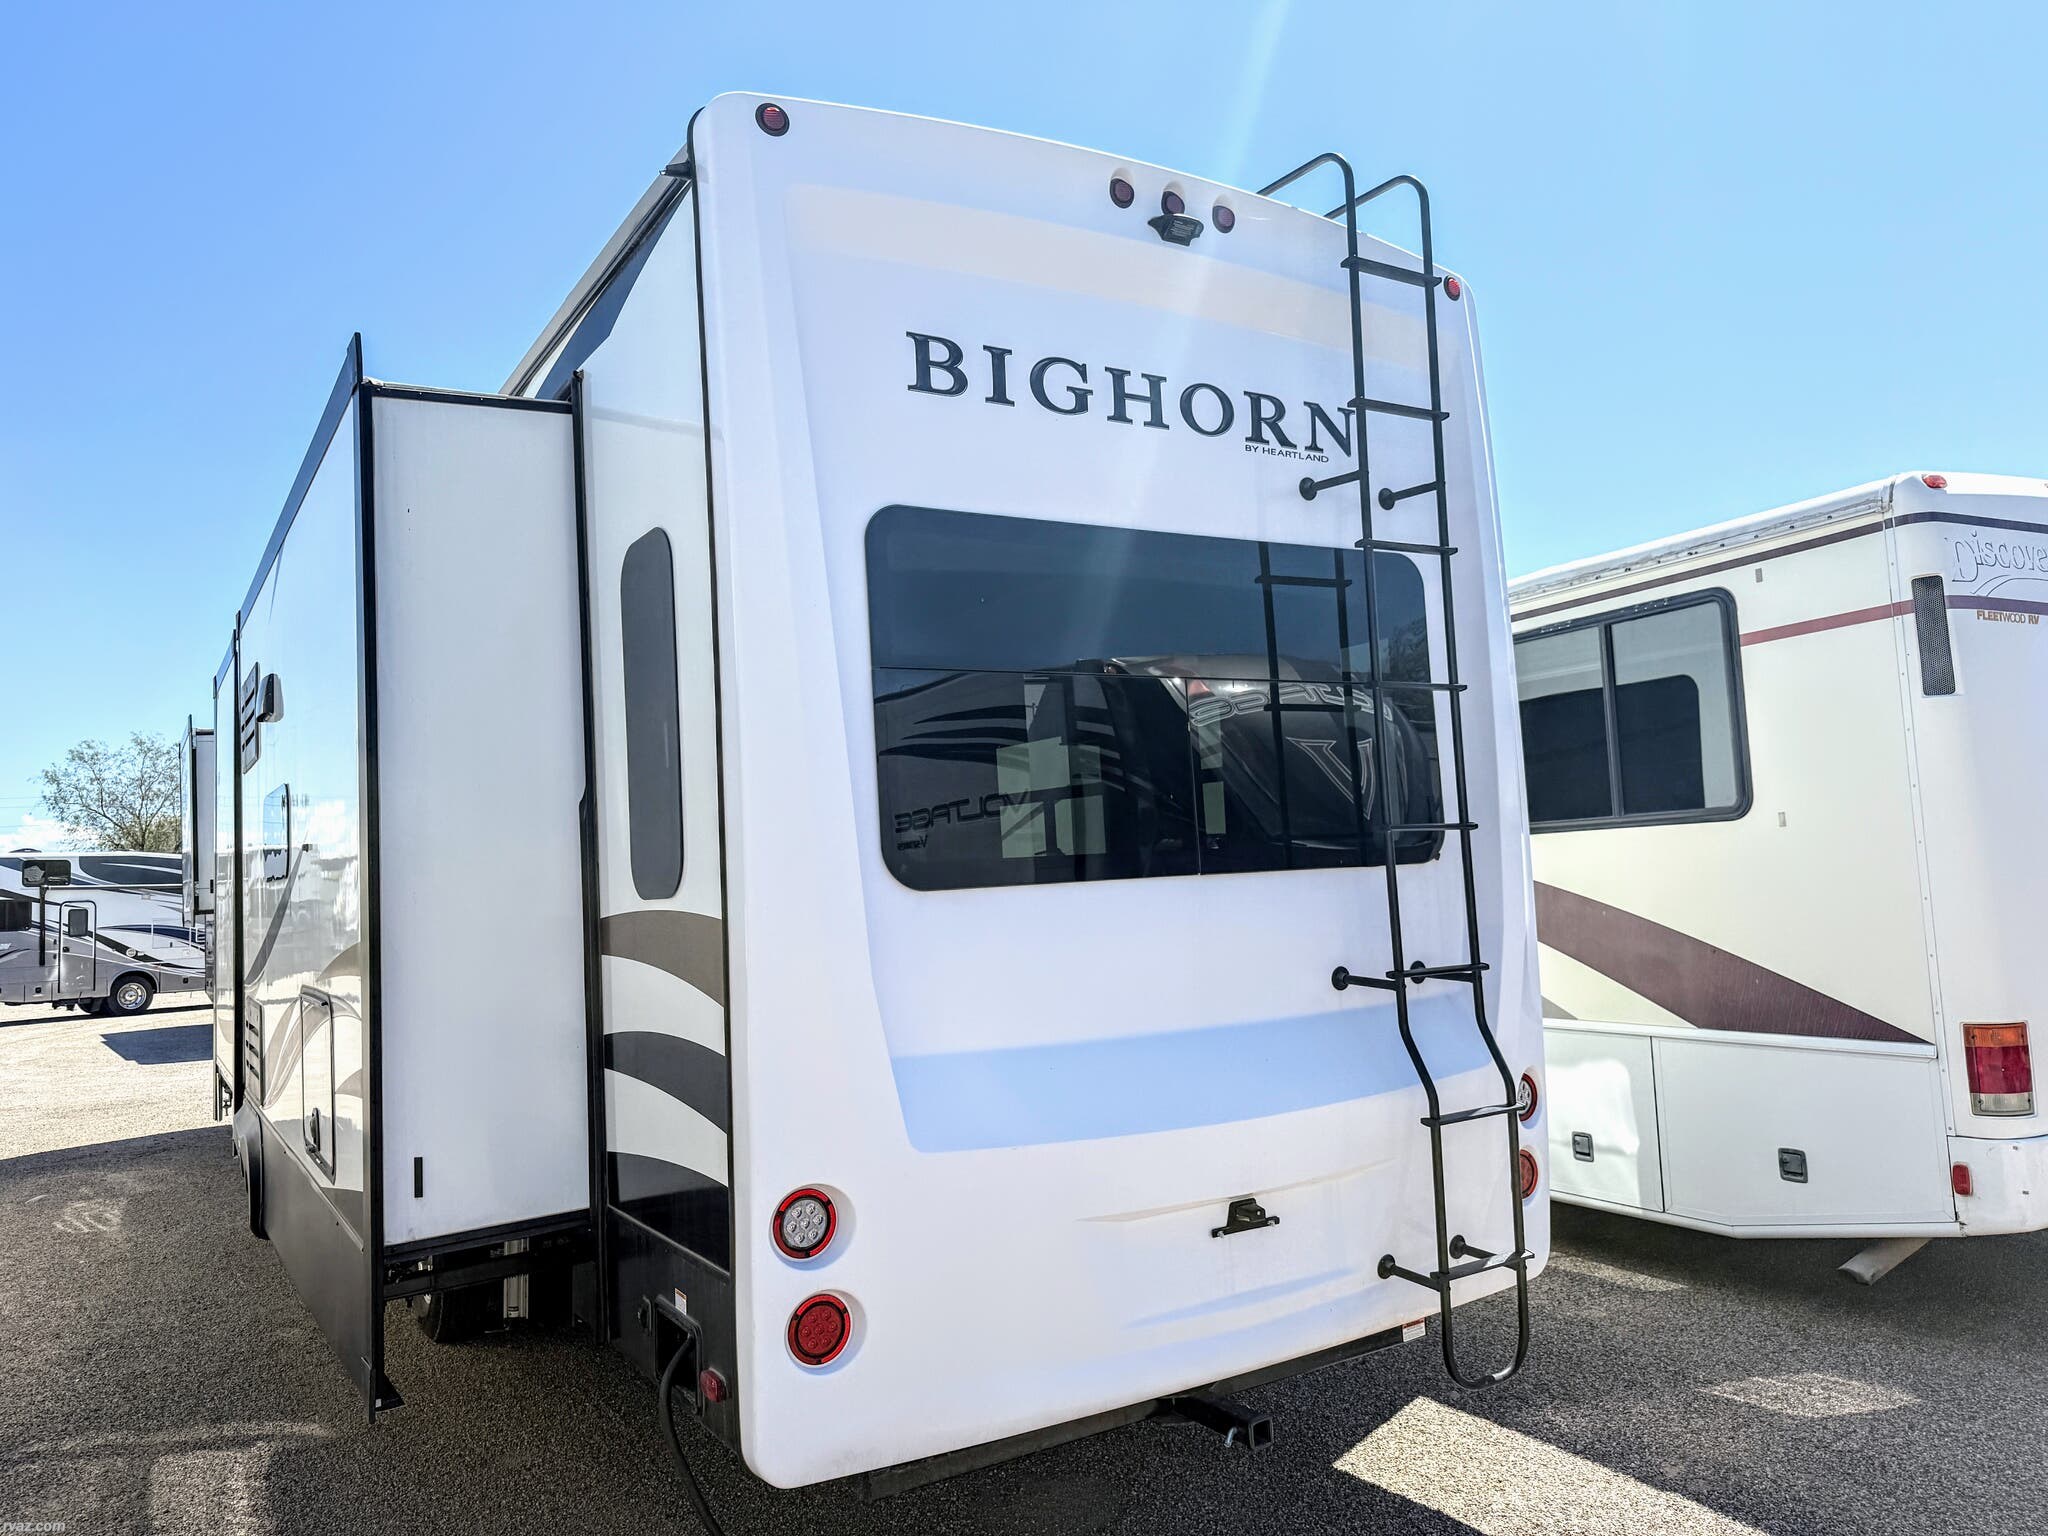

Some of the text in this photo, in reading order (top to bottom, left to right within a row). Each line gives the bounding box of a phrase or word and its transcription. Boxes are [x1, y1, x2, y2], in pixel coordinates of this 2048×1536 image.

[905, 331, 1356, 458] BIGHORN
[1245, 444, 1330, 463] BY HEARTLAND
[1976, 609, 2040, 625] FLEETWOOD RV
